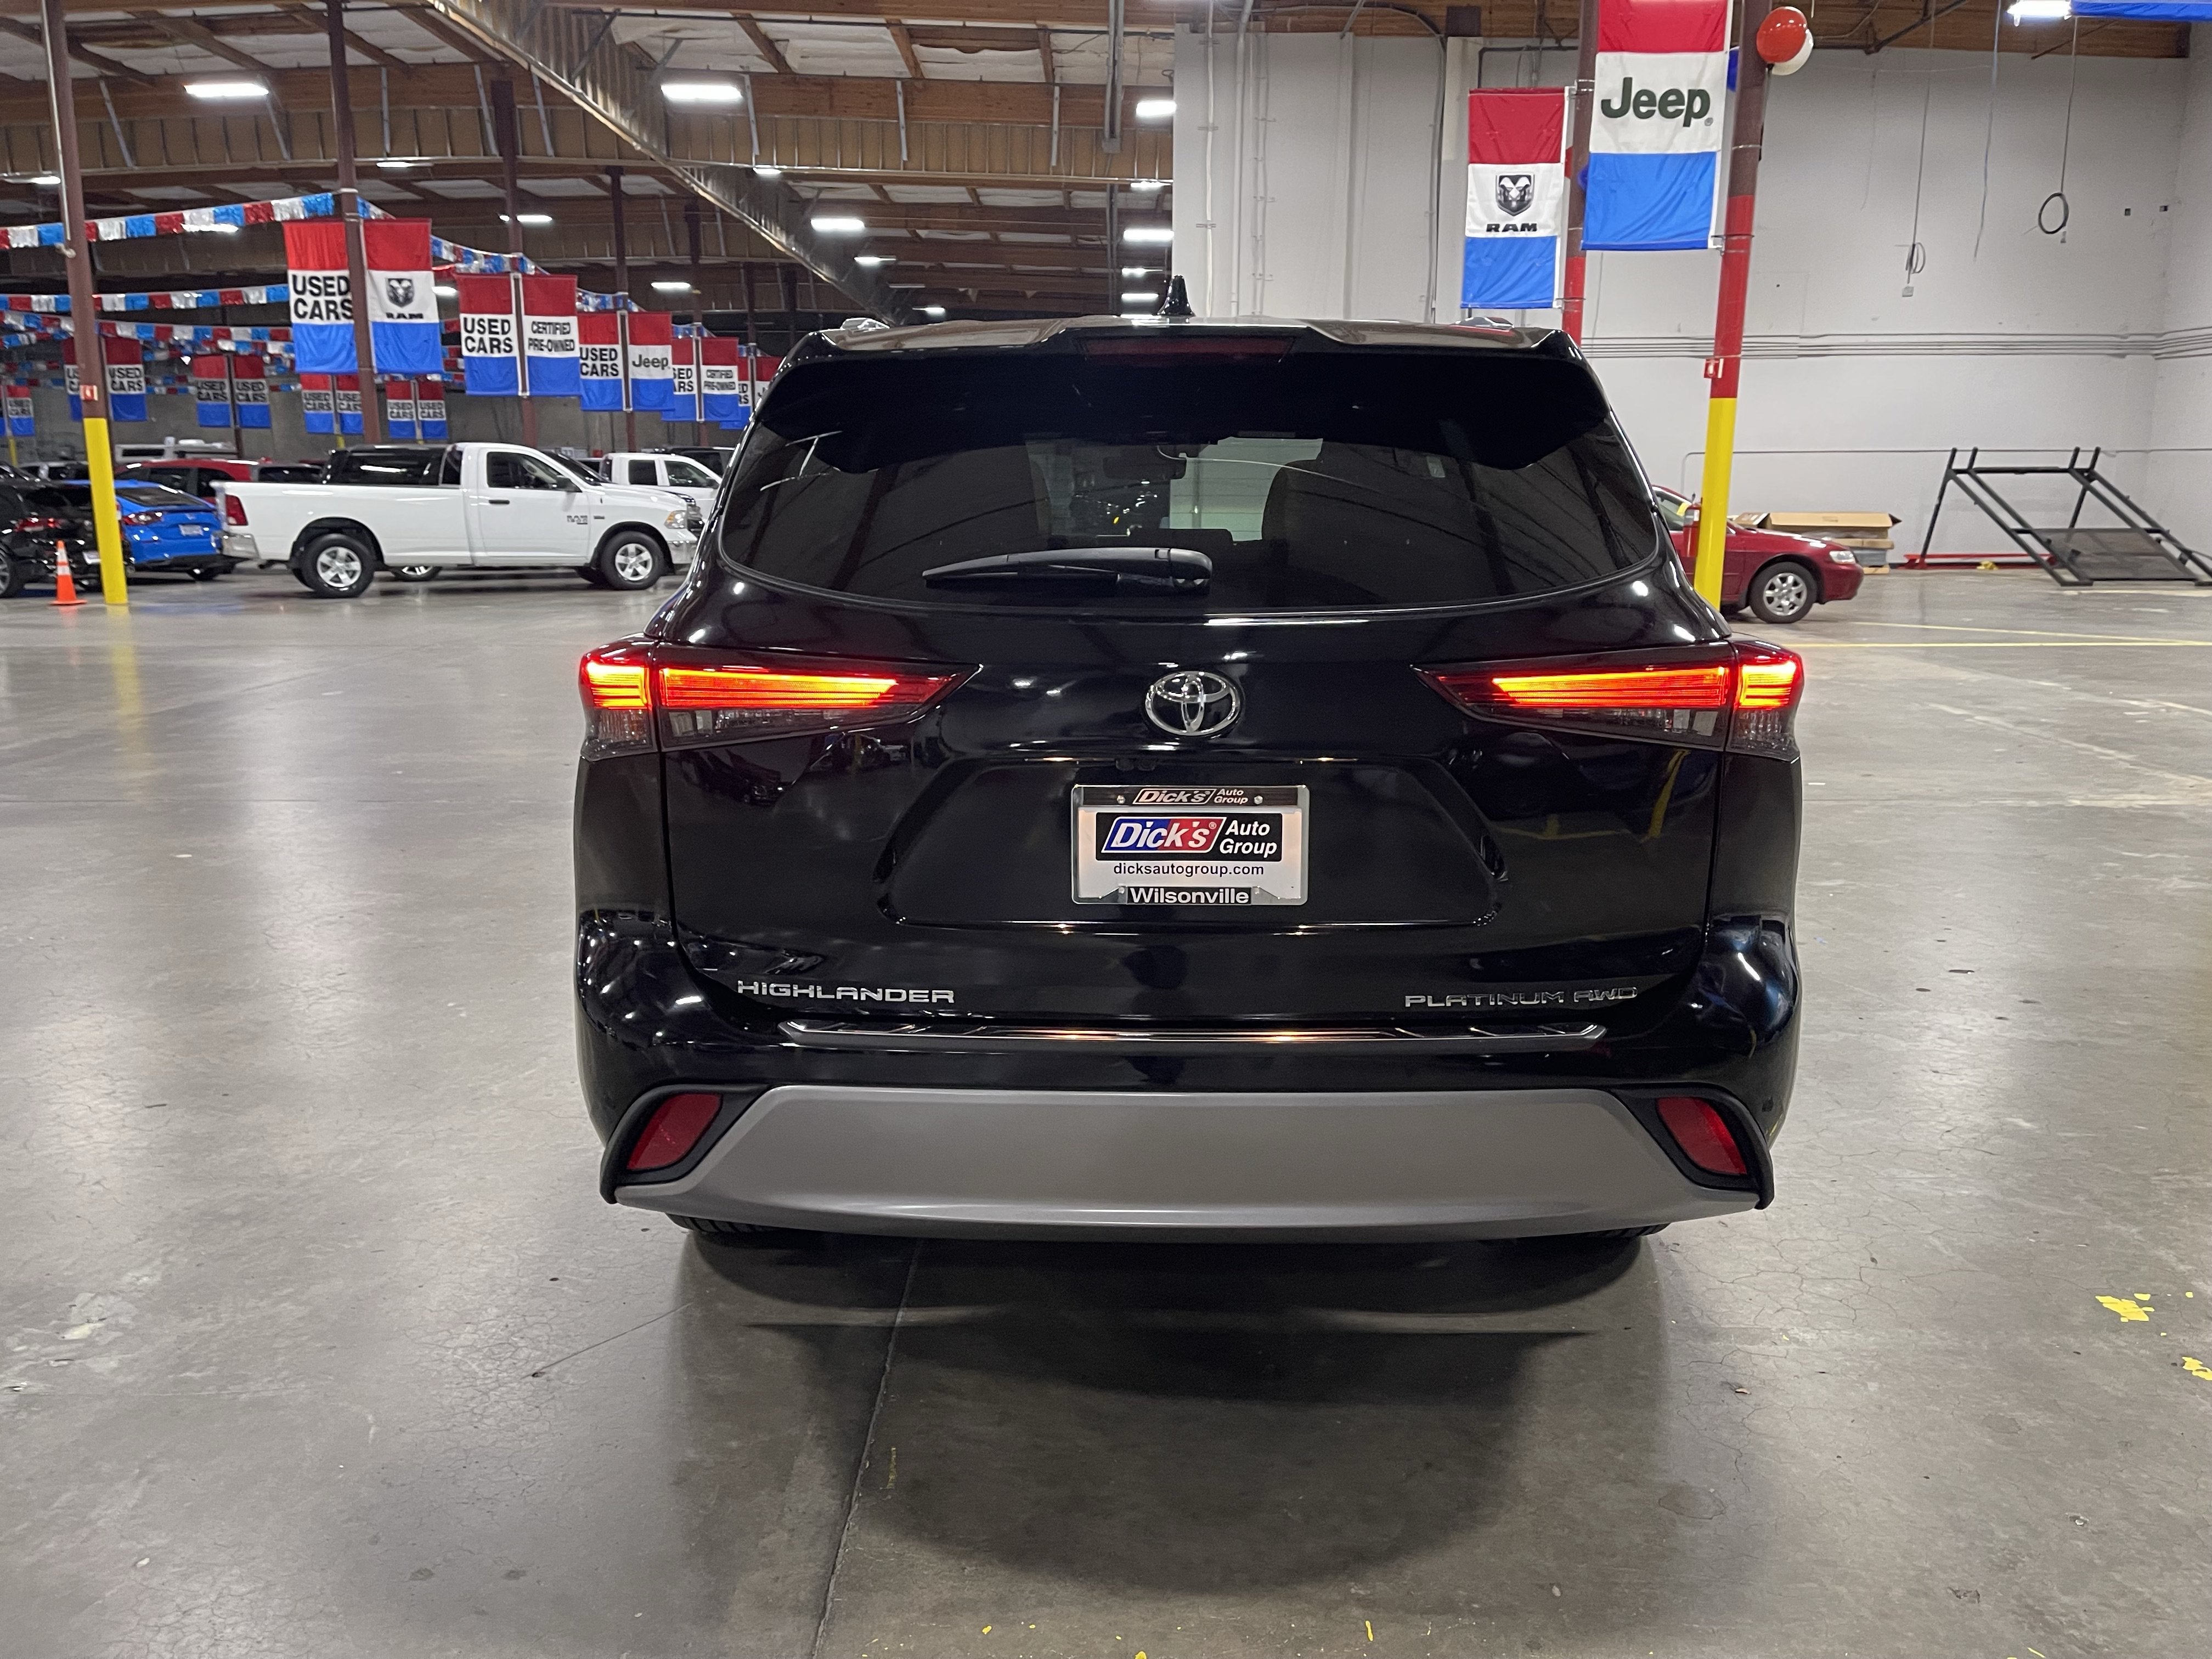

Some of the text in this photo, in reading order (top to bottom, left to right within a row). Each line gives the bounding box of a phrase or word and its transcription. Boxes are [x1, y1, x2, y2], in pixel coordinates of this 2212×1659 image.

[1600, 77, 1711, 127] Jeep
[1486, 223, 1537, 233] RAM
[292, 274, 350, 297] USED
[294, 298, 353, 320] CARS
[463, 317, 511, 335] USED
[531, 321, 571, 335] CERTIFIED
[465, 336, 513, 354] CARS
[528, 337, 575, 352] PRE-OWNED
[579, 347, 618, 362] USED
[632, 354, 669, 370] Jeep
[109, 367, 142, 379] USED
[580, 363, 619, 376] CARS
[111, 381, 143, 391] CARS
[1138, 791, 1206, 803] Dick's
[1214, 796, 1249, 805] Group
[1110, 821, 1210, 848] Dick's
[1225, 820, 1271, 836] Auto
[1220, 839, 1278, 858] Group
[1113, 863, 1264, 877] dicksautogroup.com
[1130, 887, 1249, 904] Wilsonville
[737, 980, 955, 1003] HIGHLANDER
[1404, 987, 1638, 1007] PLATINUM AWD
